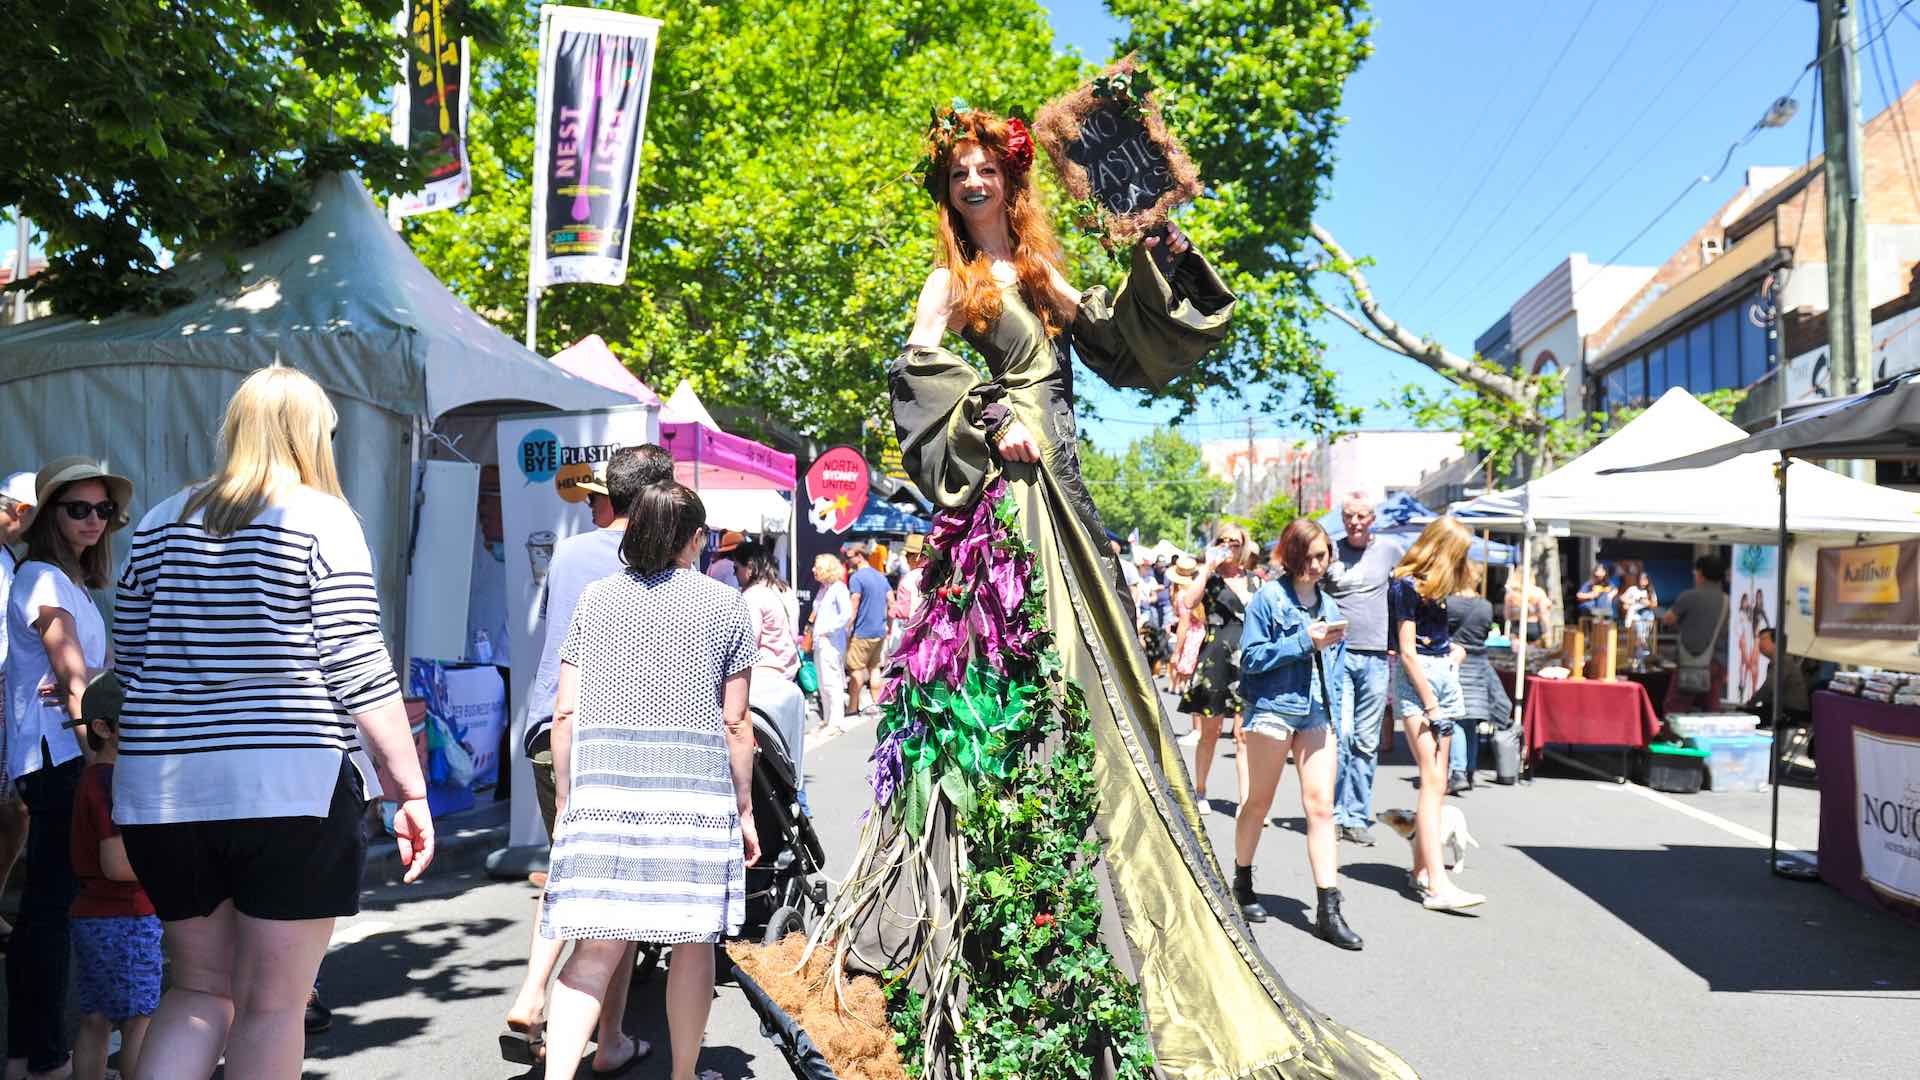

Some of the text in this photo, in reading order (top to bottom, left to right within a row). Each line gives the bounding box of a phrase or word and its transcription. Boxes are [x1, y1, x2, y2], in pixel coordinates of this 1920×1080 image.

[1078, 110, 1118, 150] NO
[555, 105, 580, 178] NEST
[1087, 130, 1162, 194] LASTIC
[1108, 166, 1174, 217] BAGS
[524, 440, 557, 456] BYE
[525, 456, 558, 472] BYE
[823, 460, 858, 472] NORTH
[558, 474, 592, 489] HELLO
[822, 470, 859, 482] SYDNEY
[822, 480, 857, 490] UNITED
